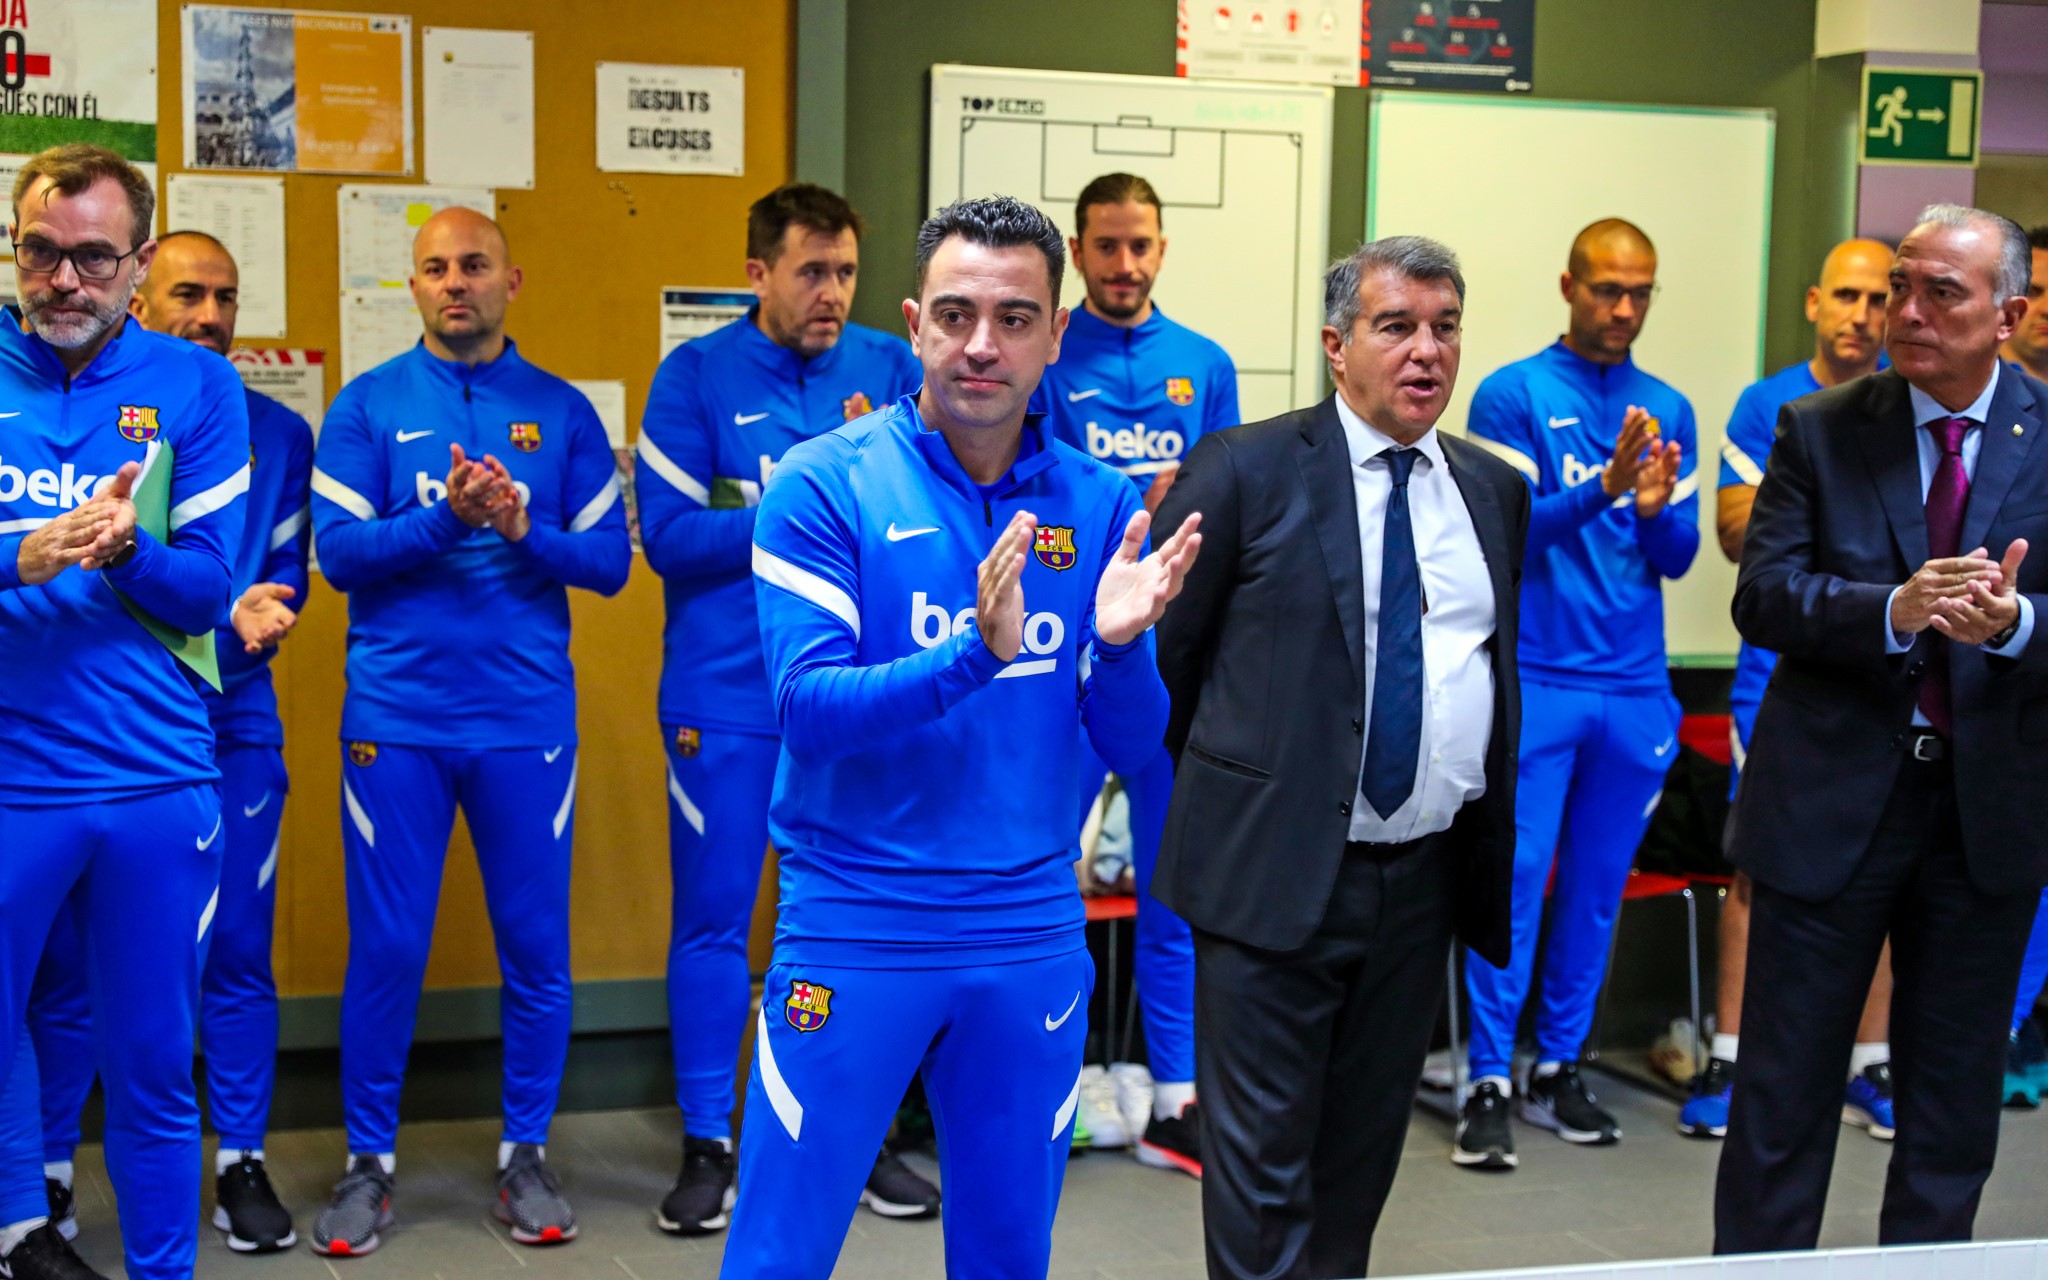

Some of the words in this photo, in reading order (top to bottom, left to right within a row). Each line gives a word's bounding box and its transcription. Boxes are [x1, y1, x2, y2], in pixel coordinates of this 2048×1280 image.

[0, 90, 37, 116] UES
[43, 92, 77, 119] CON
[83, 90, 101, 121] ÉL
[629, 88, 710, 112] RESULTS
[962, 97, 994, 111] TOP
[629, 127, 711, 150] EXCUSES
[1086, 421, 1184, 459] beko
[911, 592, 1065, 655] beo
[800, 1003, 816, 1011] FCB
